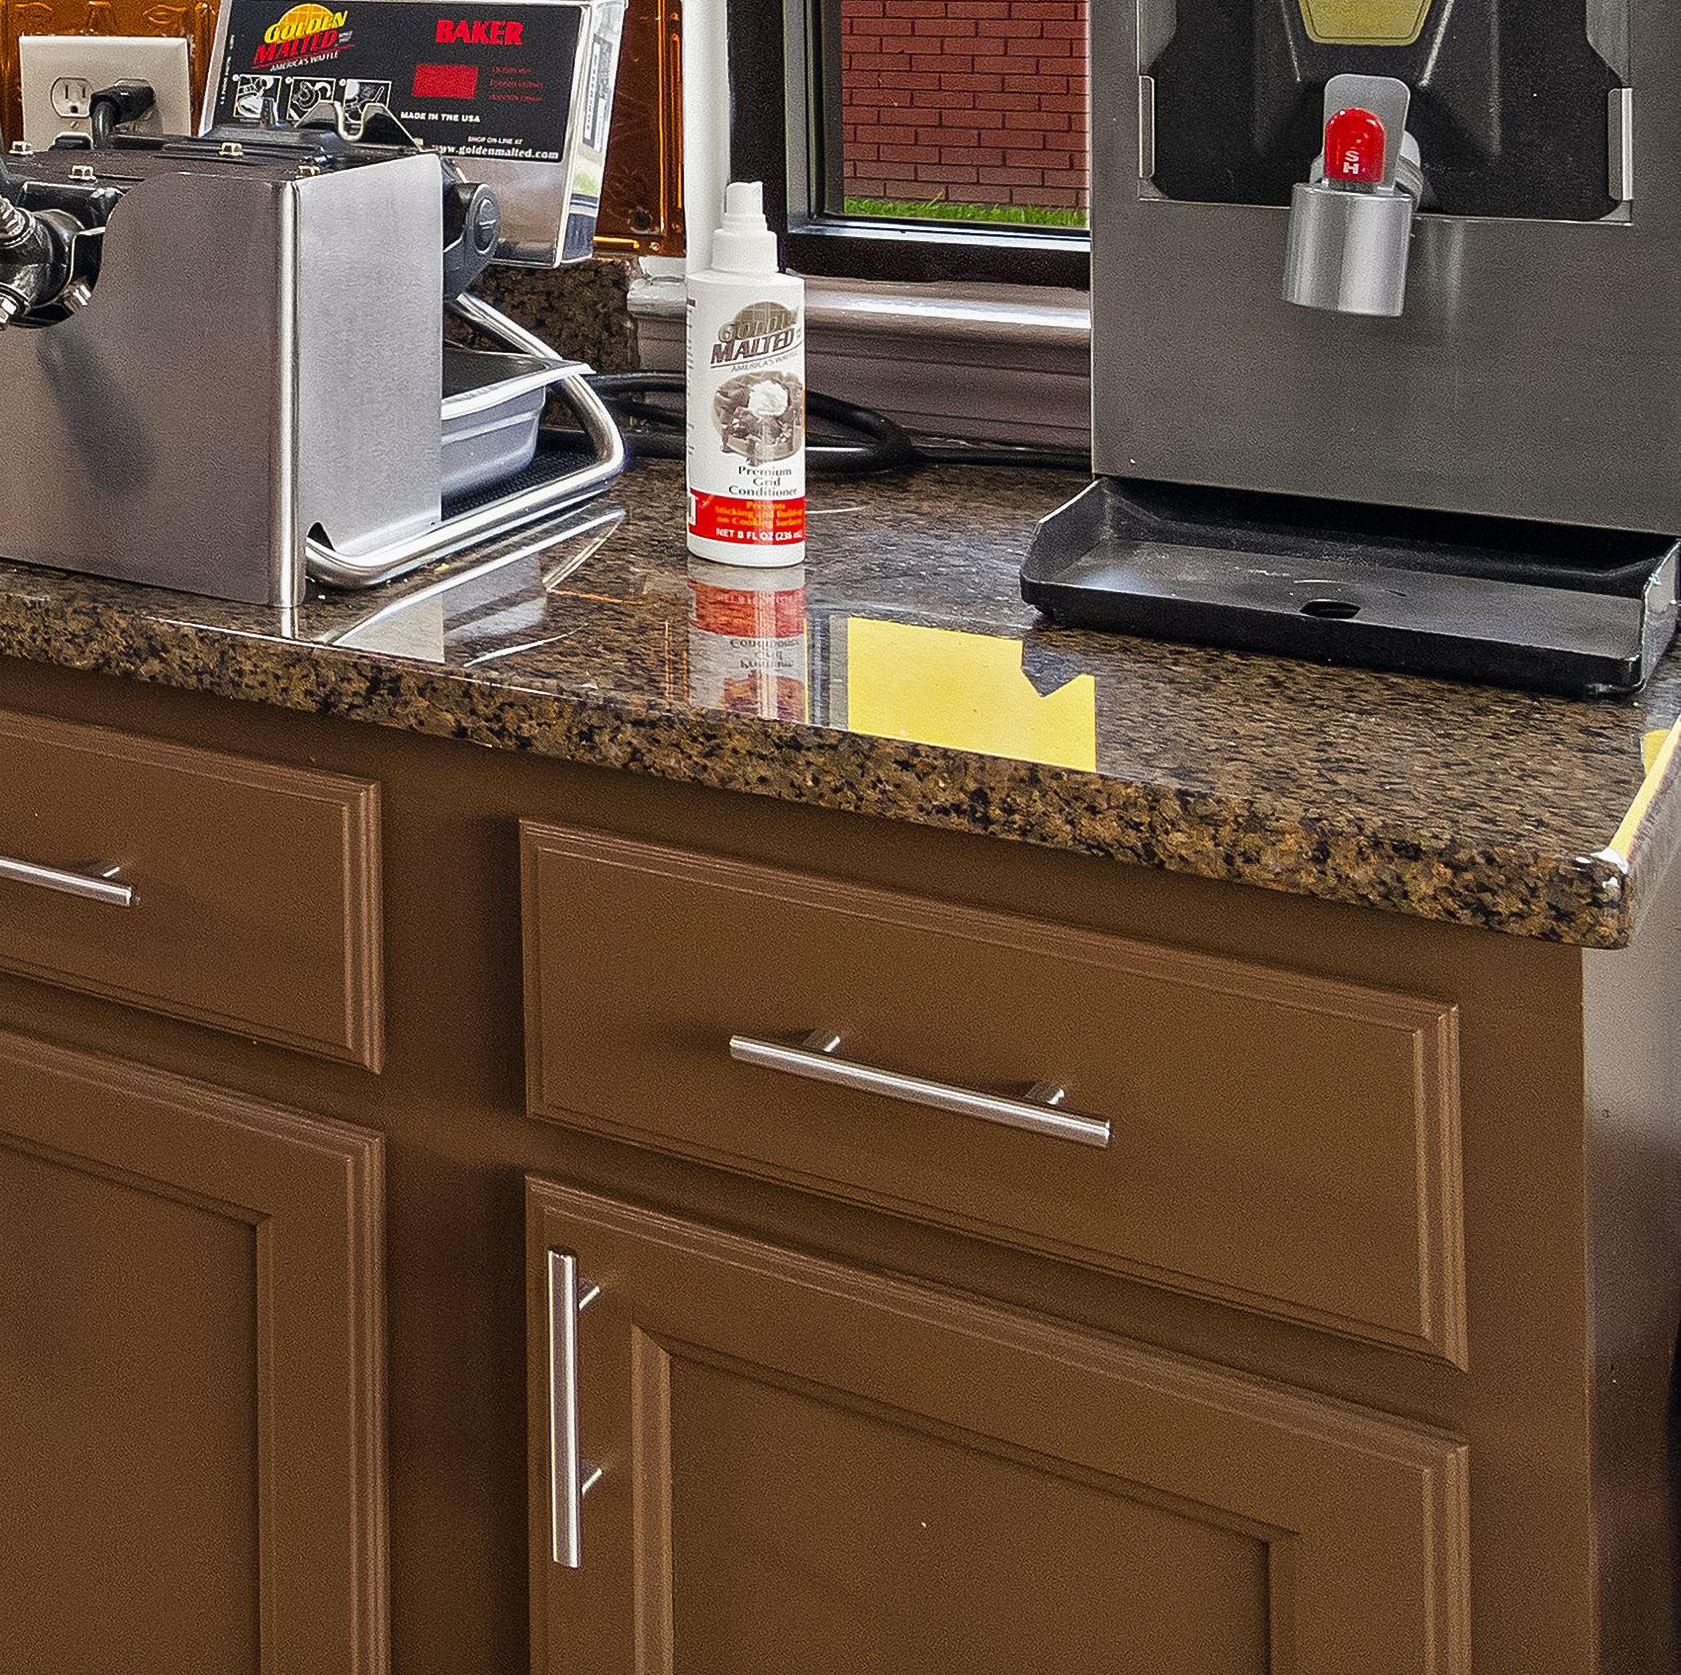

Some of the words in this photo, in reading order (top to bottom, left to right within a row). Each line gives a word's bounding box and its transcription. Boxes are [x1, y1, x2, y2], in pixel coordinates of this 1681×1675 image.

[264, 10, 348, 44] GOLDEN
[435, 19, 524, 45] BAKER
[253, 30, 338, 64] MALTED
[400, 111, 426, 120] MADE
[428, 112, 439, 121] IN
[441, 113, 459, 121] THE
[461, 114, 481, 123] USA
[710, 327, 795, 365] MALTED
[730, 359, 774, 373] AMERICA'S
[738, 465, 792, 476] Premium
[752, 477, 781, 486] Grid
[728, 485, 797, 497] Conditioner
[716, 527, 735, 538] NET
[737, 530, 744, 539] 8
[746, 531, 758, 540] FL
[759, 531, 774, 541] OZ
